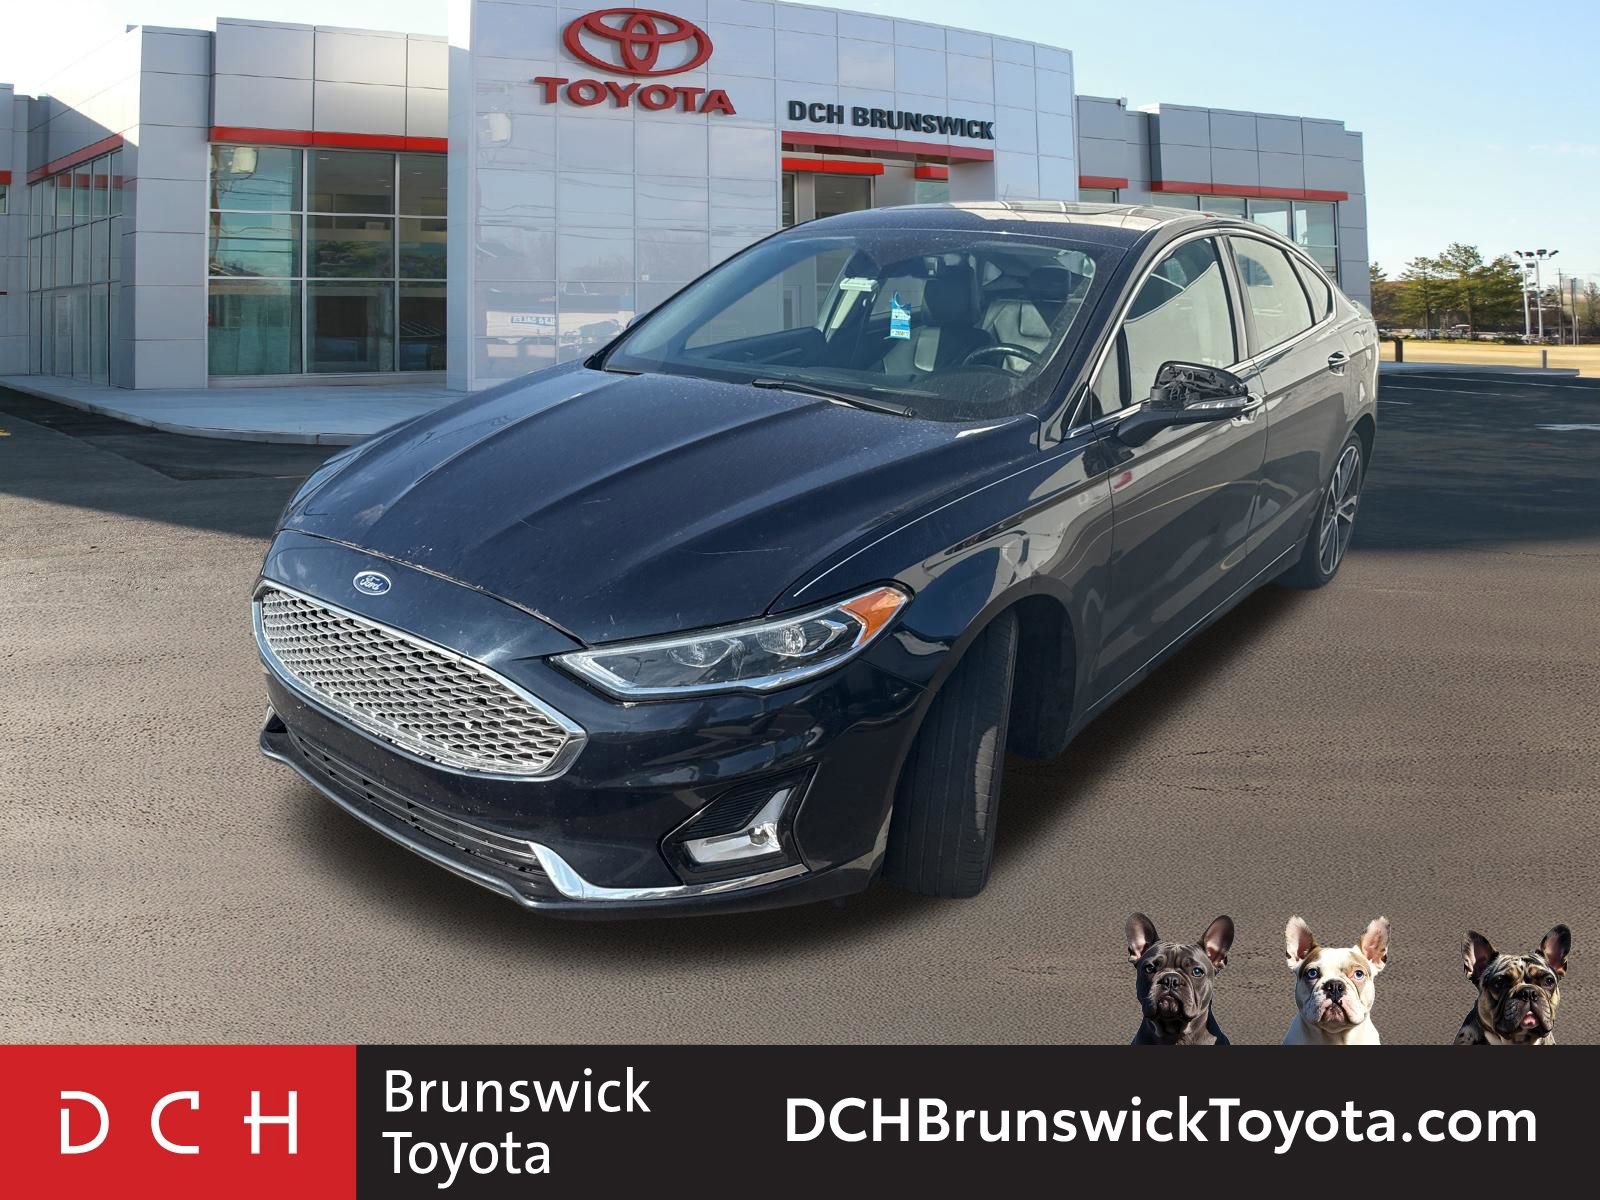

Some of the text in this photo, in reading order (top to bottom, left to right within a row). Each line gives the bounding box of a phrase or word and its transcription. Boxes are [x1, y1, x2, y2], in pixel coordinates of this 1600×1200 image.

[534, 76, 737, 115] TOYOTA
[788, 100, 994, 139] DCH BRUNSWICK
